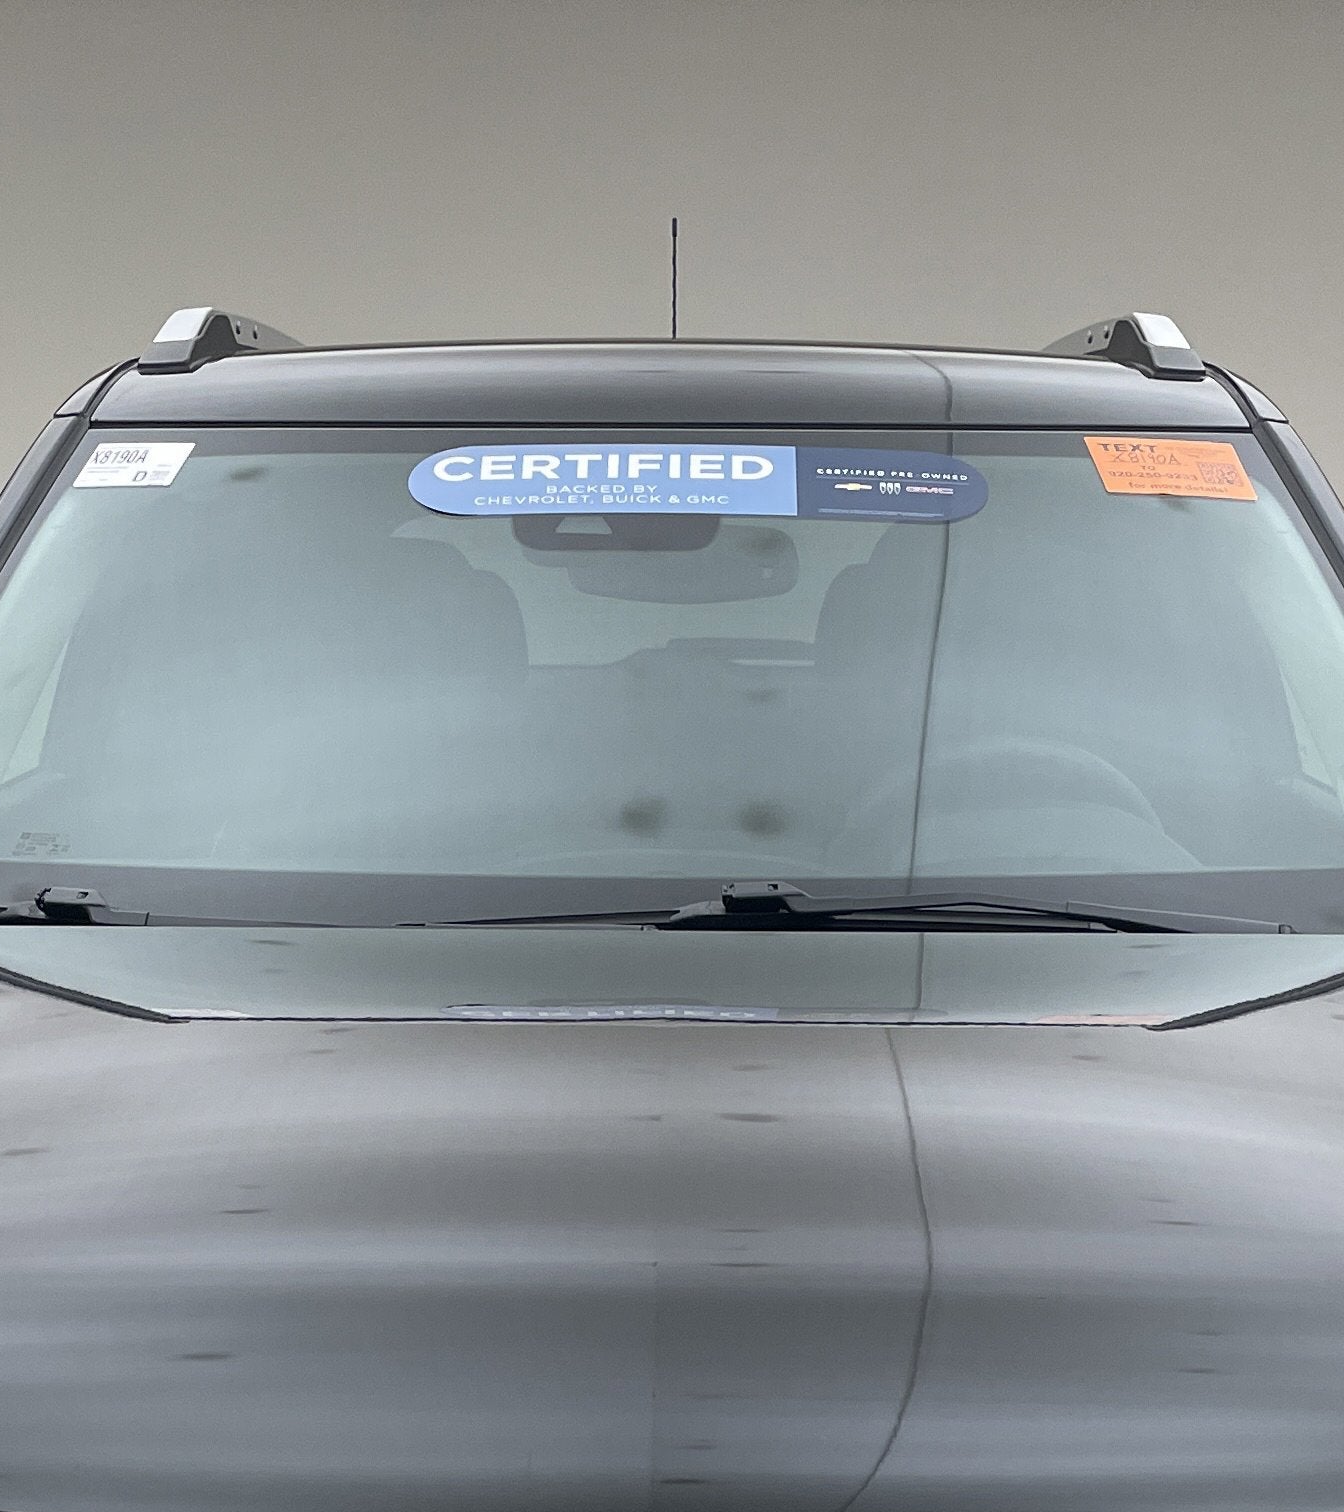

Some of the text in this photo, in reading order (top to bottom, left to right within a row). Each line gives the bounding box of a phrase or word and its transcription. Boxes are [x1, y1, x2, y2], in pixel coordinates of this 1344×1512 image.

[1097, 443, 1157, 453] TEXT
[92, 449, 150, 464] X8190A
[433, 453, 774, 482] CERTIFIED
[816, 468, 885, 477] CERTIFIED
[546, 484, 658, 494] BACKED BY
[905, 485, 954, 495] GMC
[602, 493, 661, 504] BUICK
[668, 493, 681, 504] &
[686, 494, 730, 505] GMC
